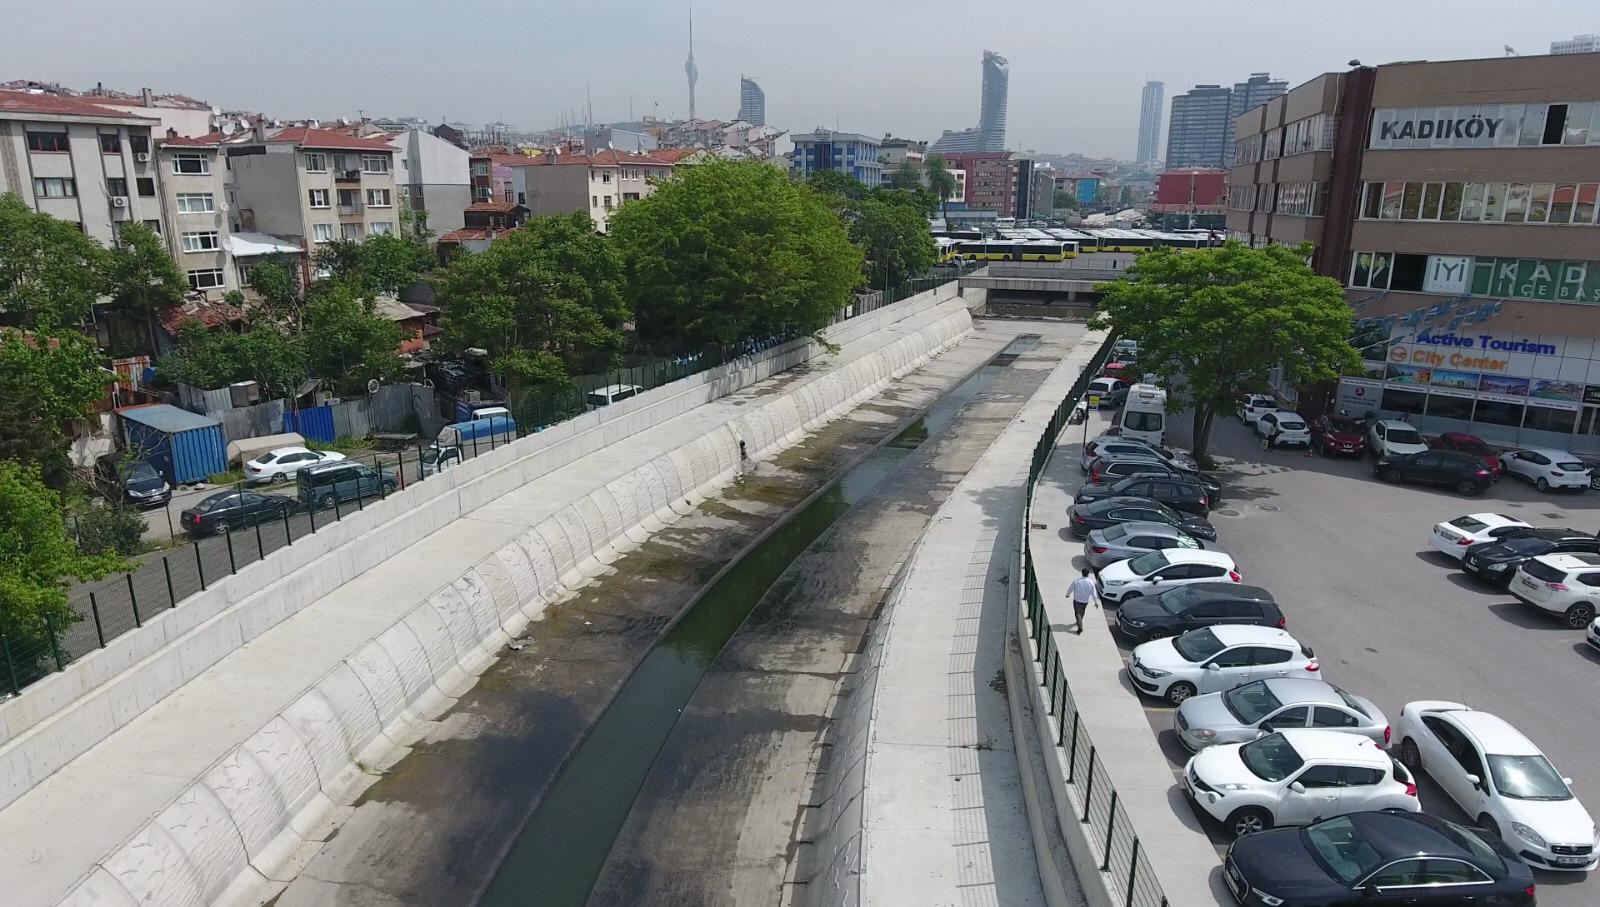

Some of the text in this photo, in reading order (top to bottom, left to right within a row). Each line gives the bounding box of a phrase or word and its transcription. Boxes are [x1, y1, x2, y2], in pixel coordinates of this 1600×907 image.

[1380, 114, 1503, 140] KADIKÖY
[1416, 331, 1556, 355] Active Tourism
[1413, 350, 1508, 370] City Center
